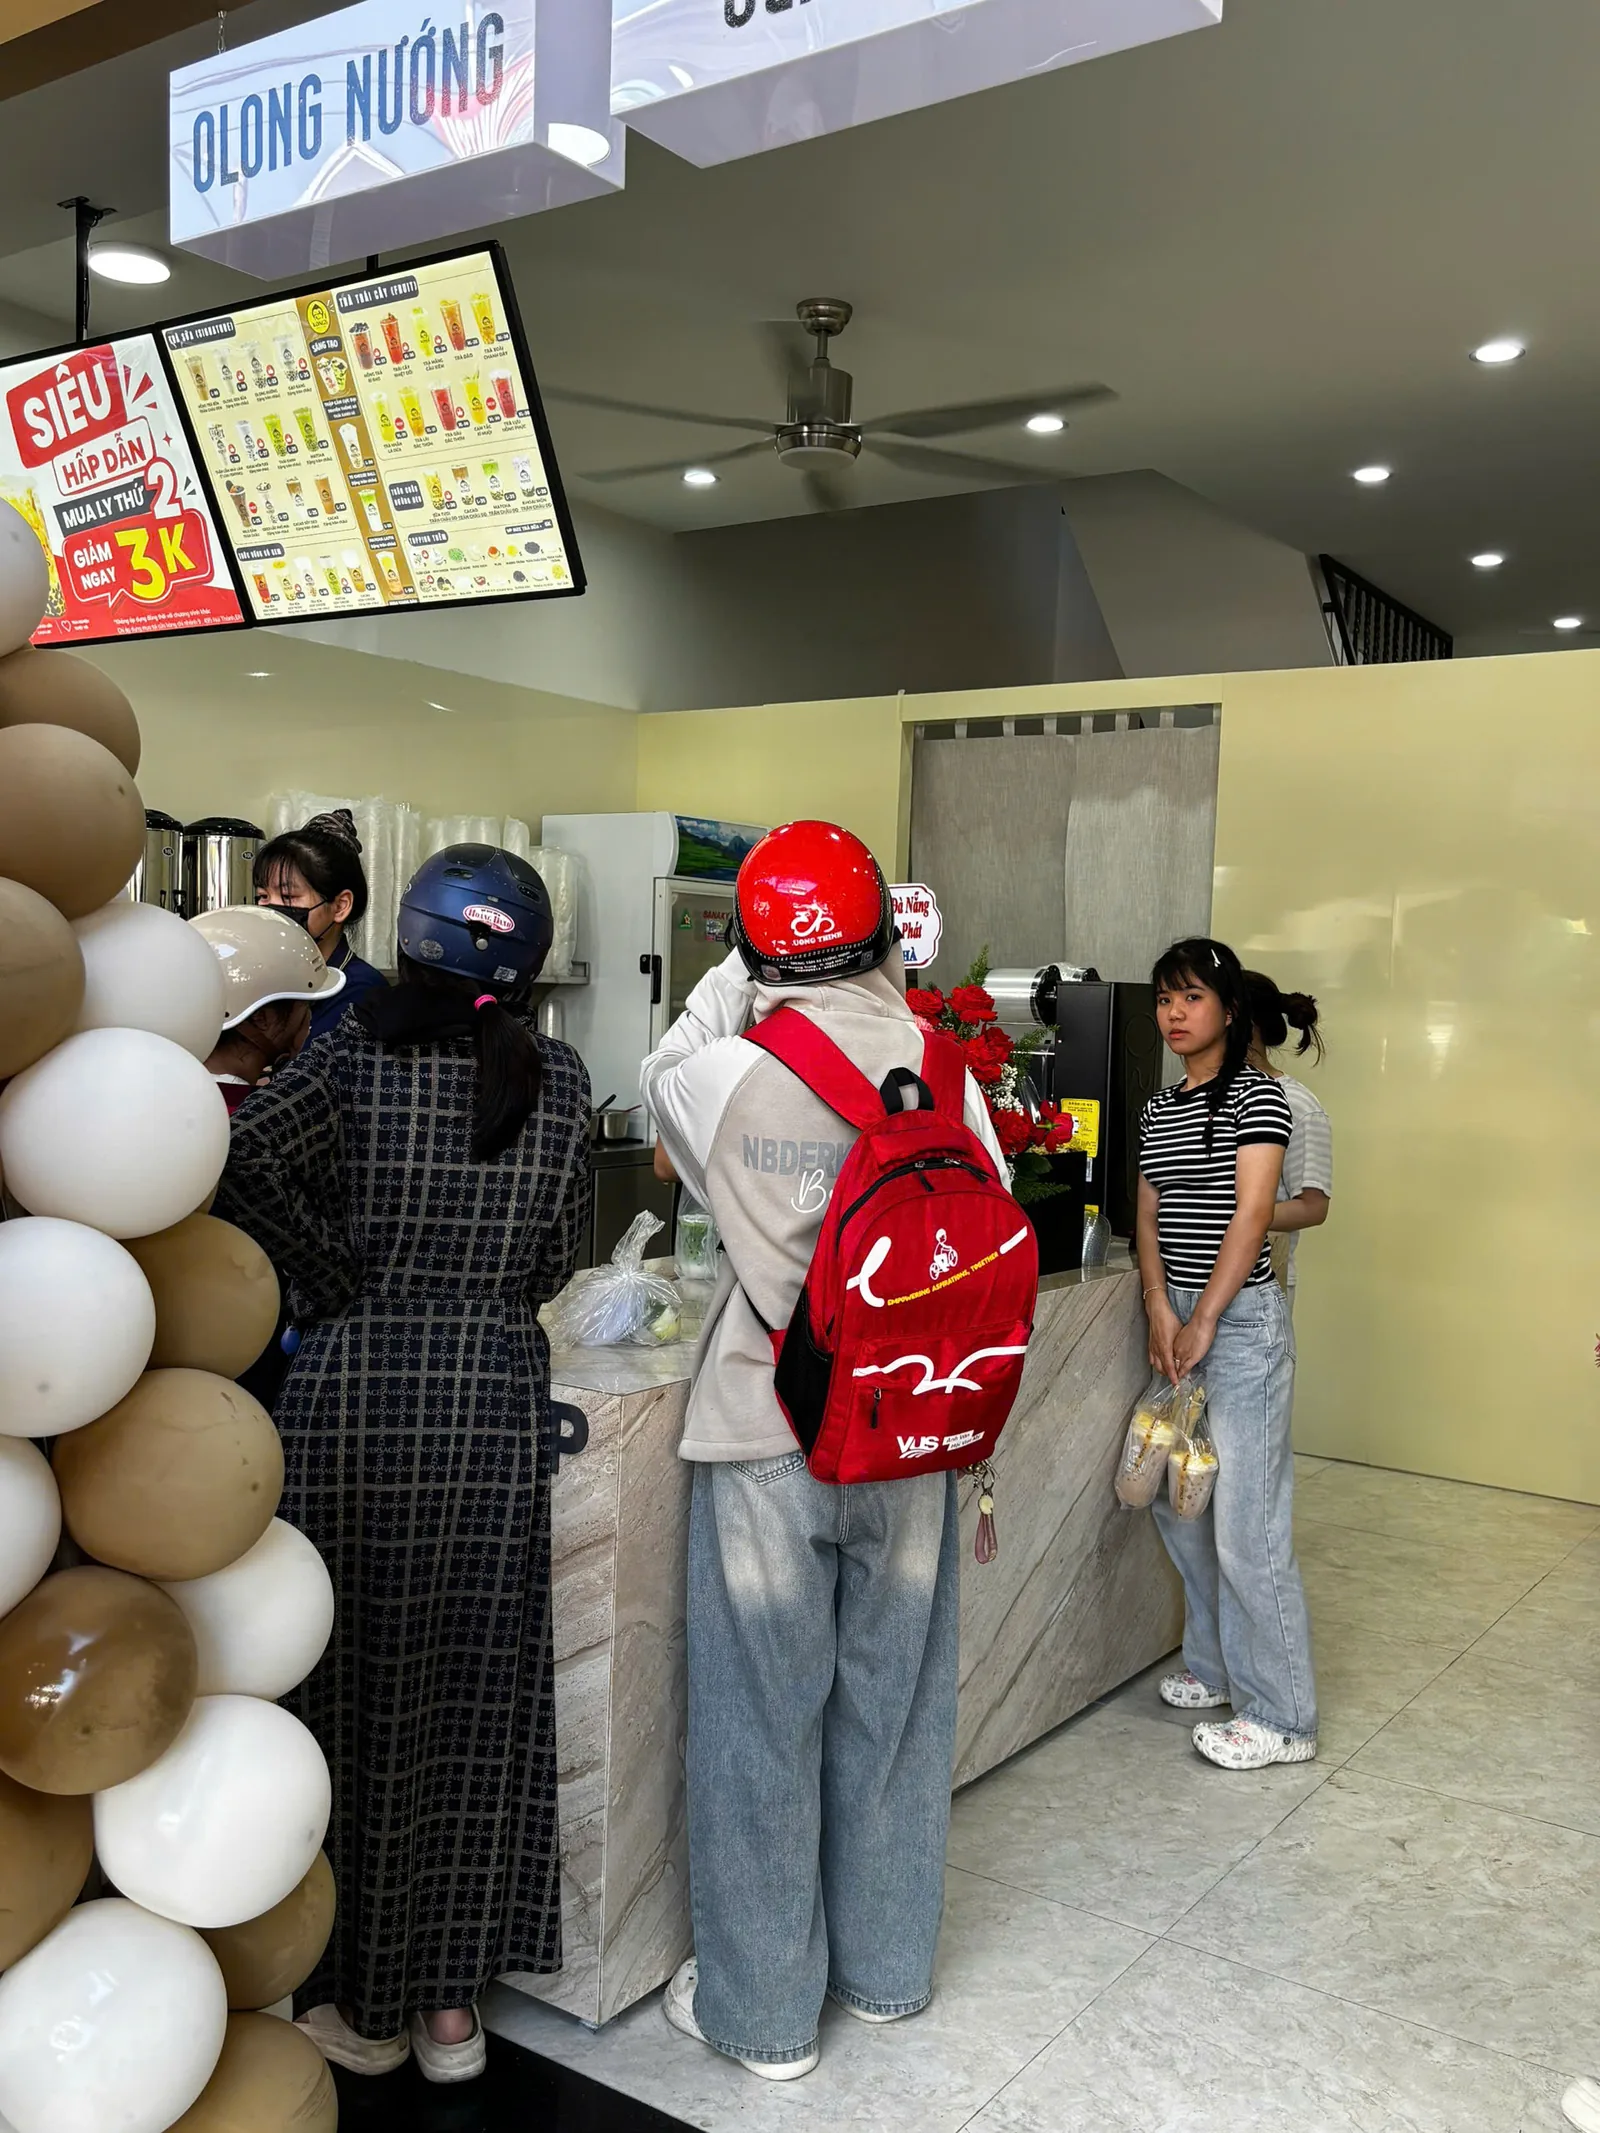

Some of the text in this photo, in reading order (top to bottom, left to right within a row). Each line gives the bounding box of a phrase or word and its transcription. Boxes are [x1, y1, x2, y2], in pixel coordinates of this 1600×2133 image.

[193, 12, 504, 193] OLONG NƯỚNG
[338, 293, 353, 307] TRÀ
[354, 289, 372, 303] TRÁI
[372, 285, 388, 299] CÂY
[311, 338, 338, 352] SÁNG TẠO
[23, 362, 113, 449] SIÊU
[62, 431, 147, 489] HẤP DẪN
[62, 461, 183, 530] MUA LY THỨ 2
[408, 534, 431, 544] TOPPING
[73, 541, 113, 569] GIẢM
[80, 566, 118, 590] NGAY
[905, 891, 930, 917] Nẵng
[817, 930, 843, 944] THINH
[887, 1251, 999, 1306] EMPOWERING ASPIRATIONS, TOGETHER
[896, 1436, 939, 1453] VUS
